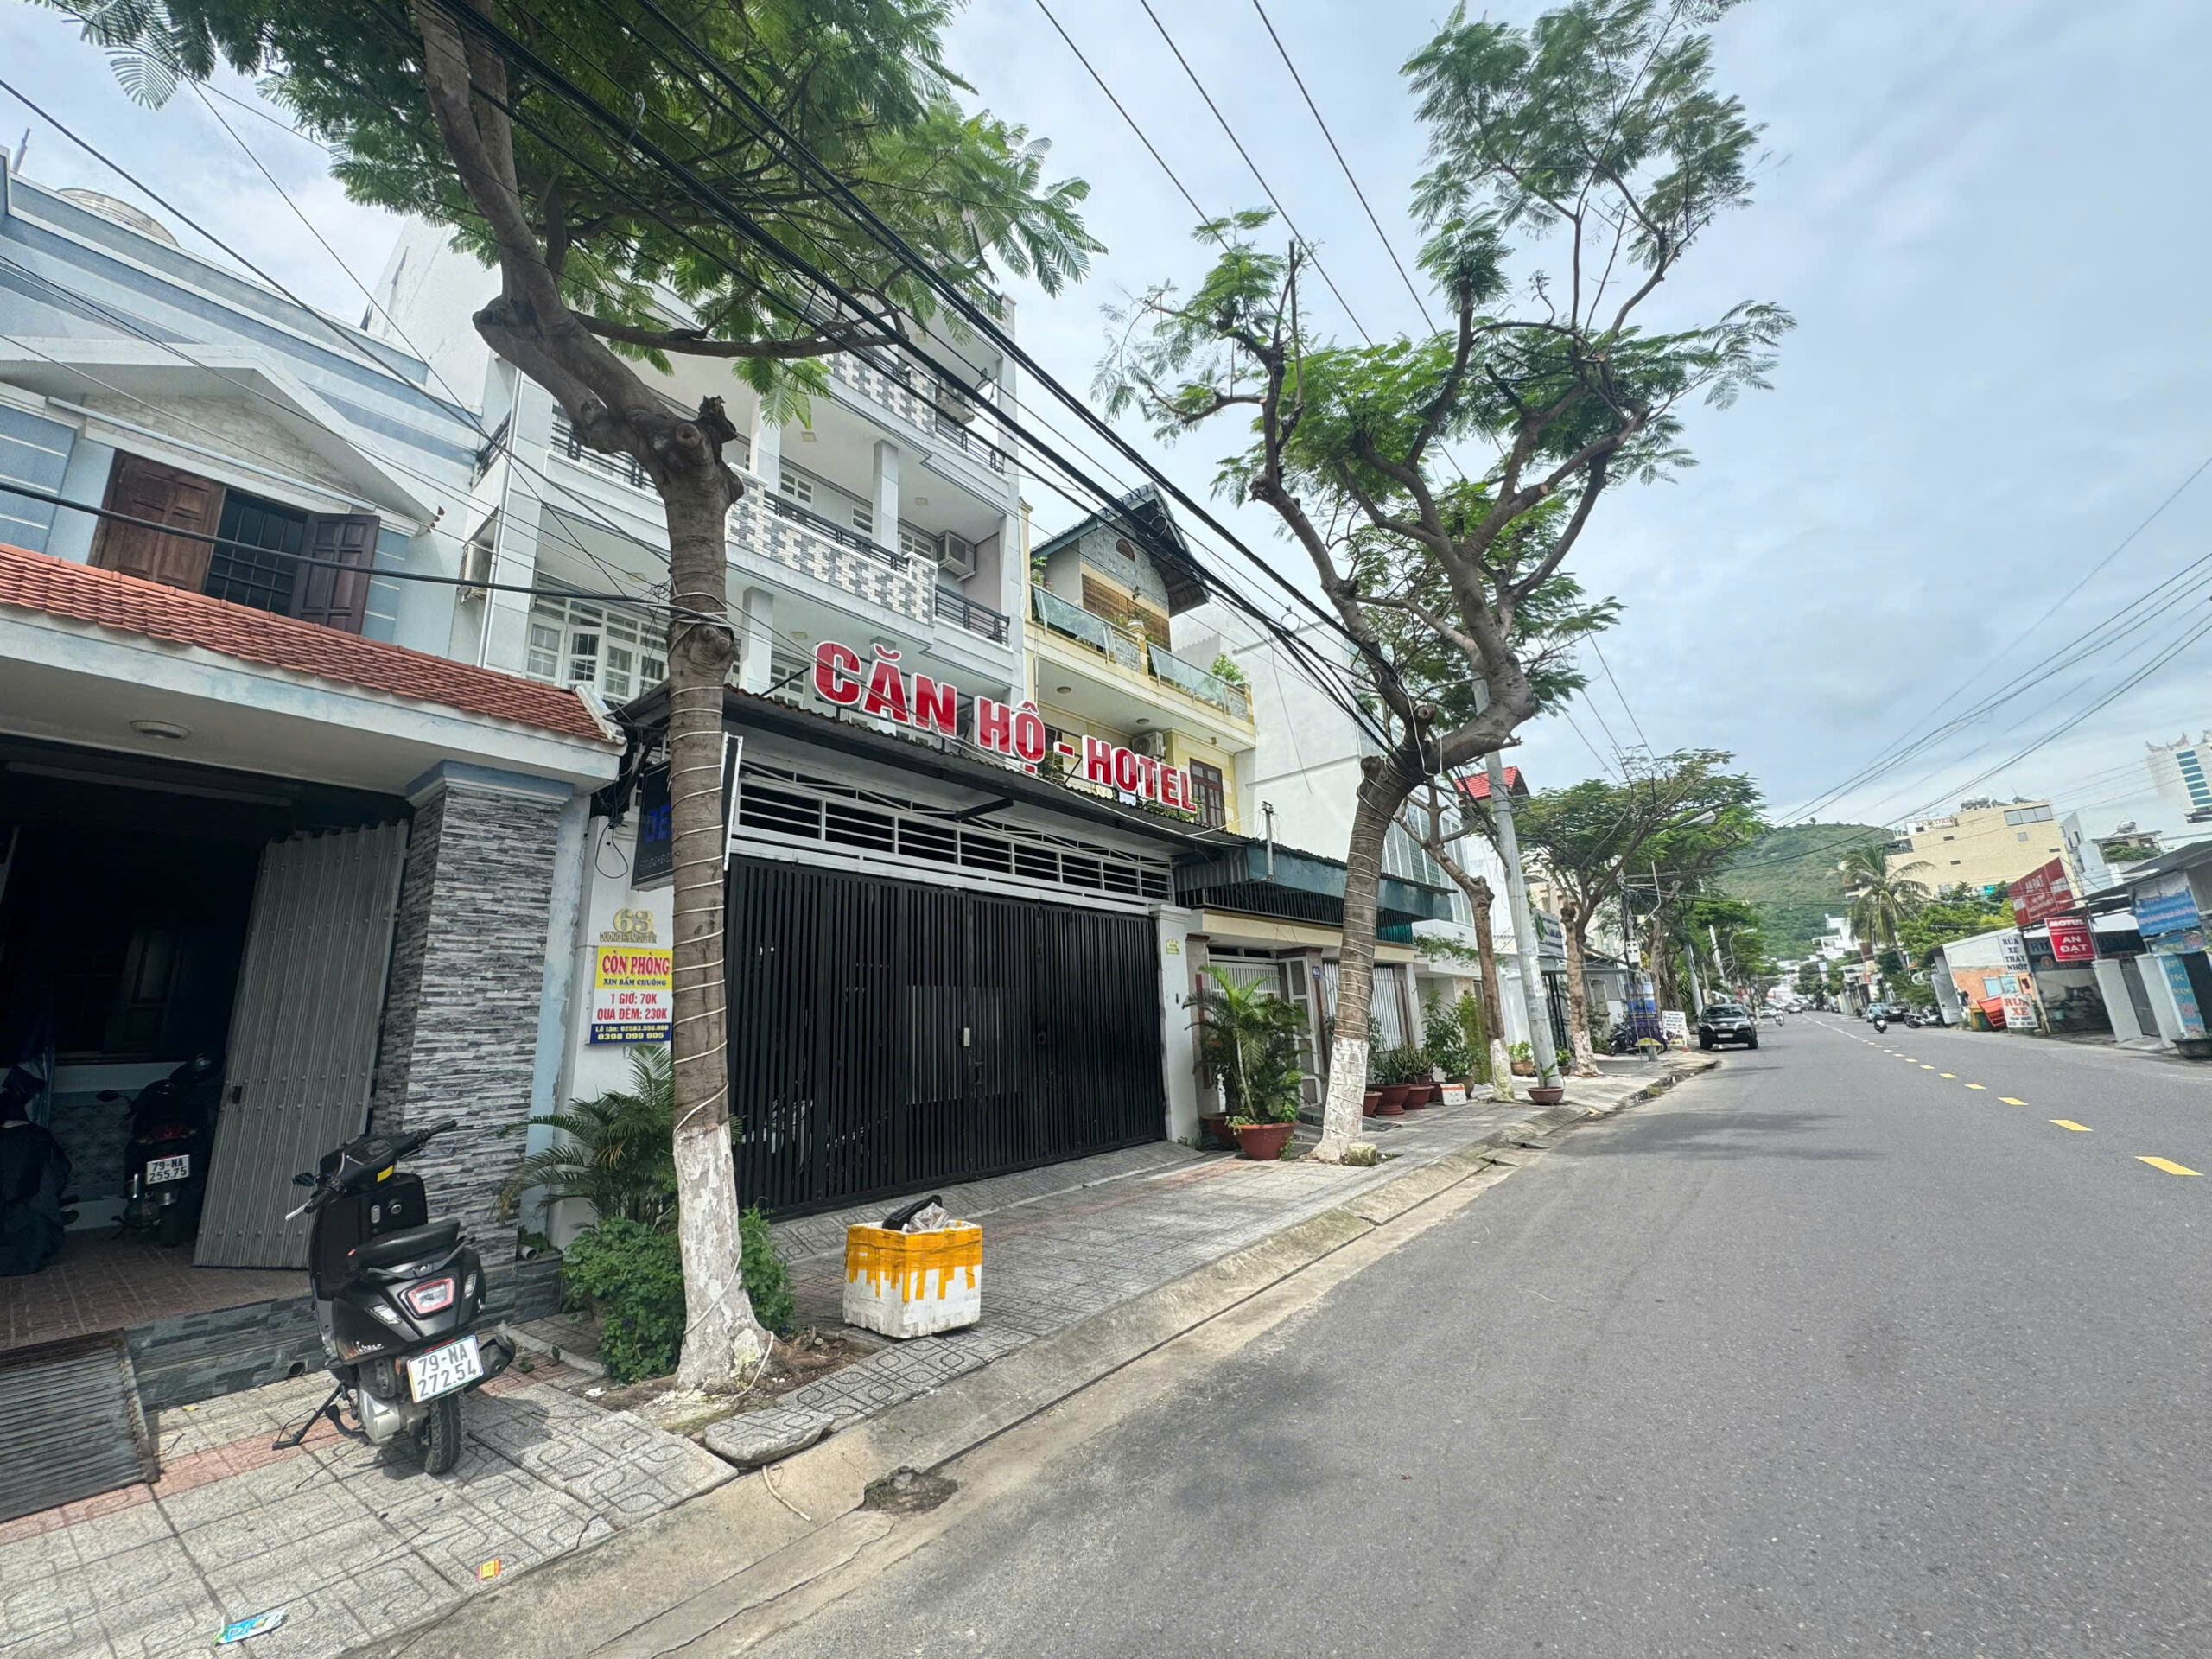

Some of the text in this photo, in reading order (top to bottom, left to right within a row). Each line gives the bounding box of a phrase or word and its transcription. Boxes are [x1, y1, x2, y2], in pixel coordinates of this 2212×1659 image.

[813, 640, 957, 737] CĂN
[974, 696, 1046, 776] HỘ
[1082, 734, 1198, 814] HOTEL
[613, 907, 654, 933] 63
[2060, 944, 2088, 953] ĐẠT
[602, 950, 670, 976] CÒN PHÒNG
[620, 976, 635, 986] BẤM
[611, 990, 657, 1004] 1 GIỜ: 70K
[597, 1006, 667, 1021] QUA ĐÊM: 230K
[152, 1158, 184, 1172] 79-NA
[149, 1166, 188, 1182] 255.75
[418, 1343, 468, 1376] 79-NA
[417, 1359, 477, 1398] 272.54
